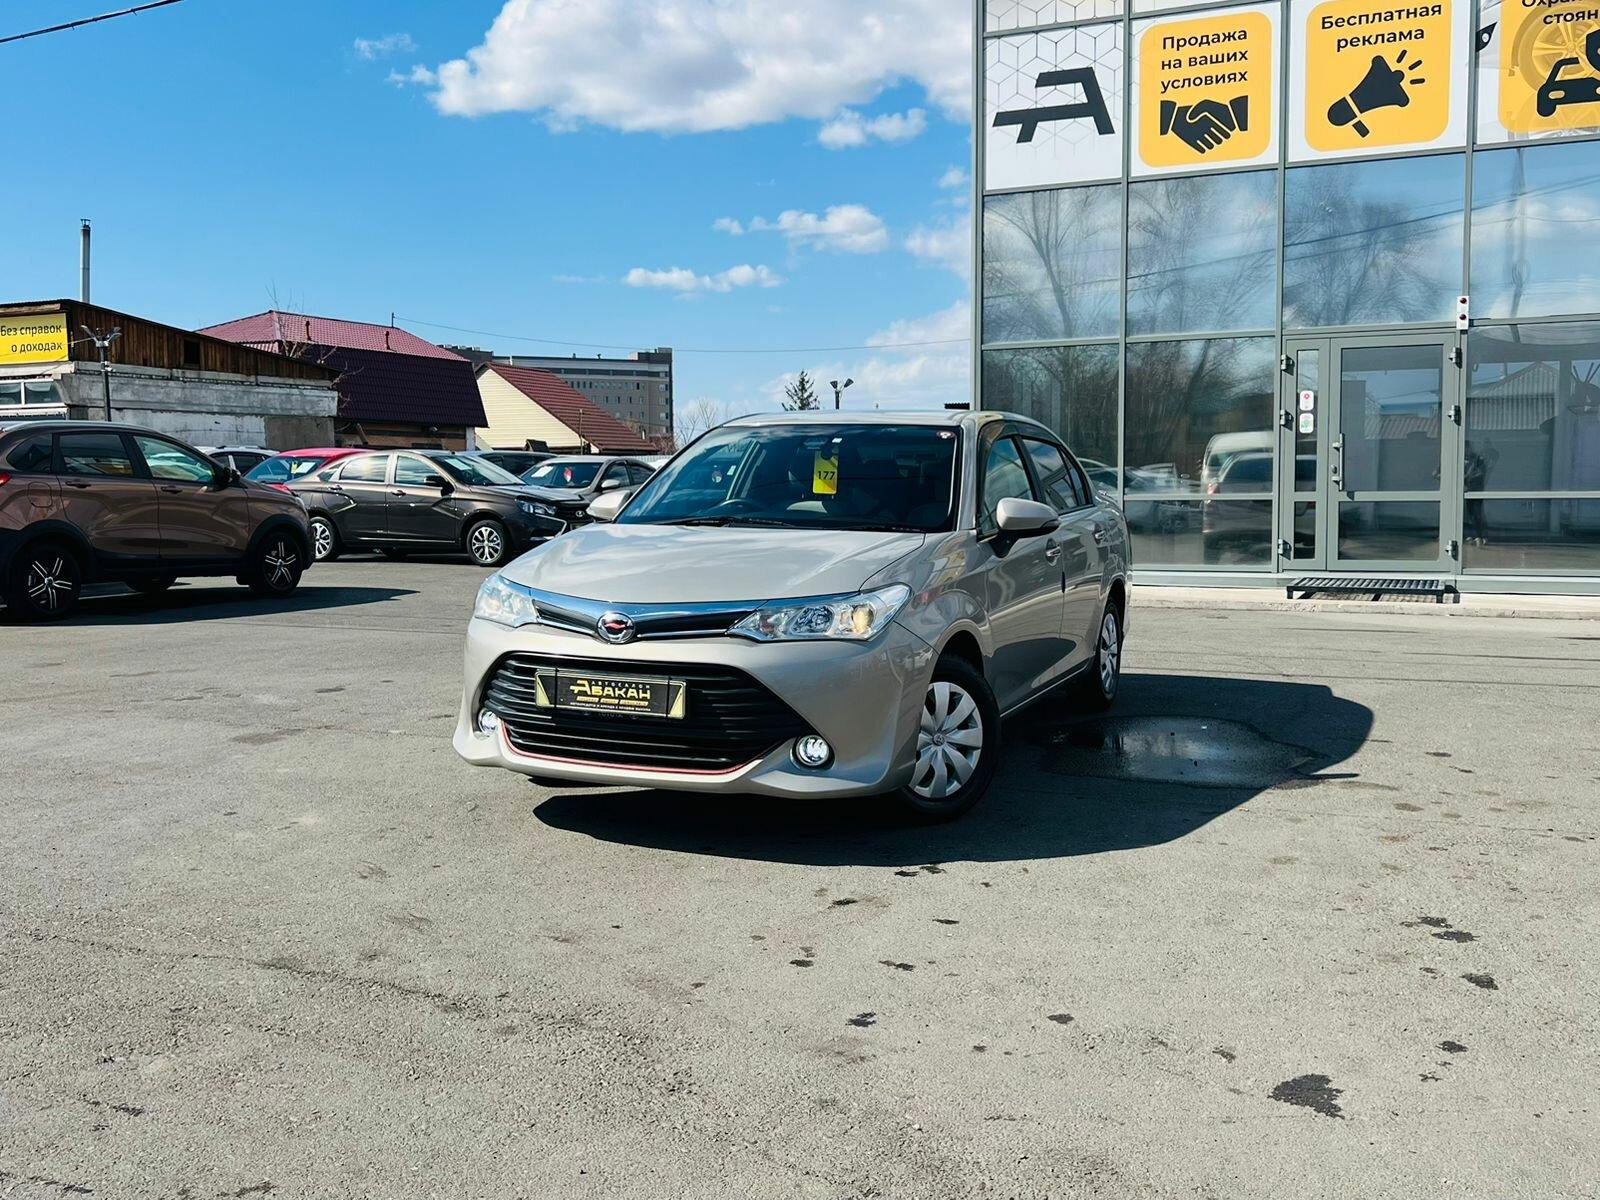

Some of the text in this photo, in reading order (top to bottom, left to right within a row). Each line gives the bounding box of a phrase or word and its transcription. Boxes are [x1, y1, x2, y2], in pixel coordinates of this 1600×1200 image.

[1321, 4, 1442, 30] Бесплатная
[1543, 9, 1599, 25] стоян
[1162, 29, 1248, 51] Продажа
[1336, 28, 1425, 52] реклама
[1161, 50, 1248, 70] на ваших
[1160, 70, 1248, 94] условиях
[0, 324, 62, 338] Без справок
[11, 342, 63, 354] о доходах
[817, 470, 836, 480] 177
[569, 679, 651, 700] АБАКАН
